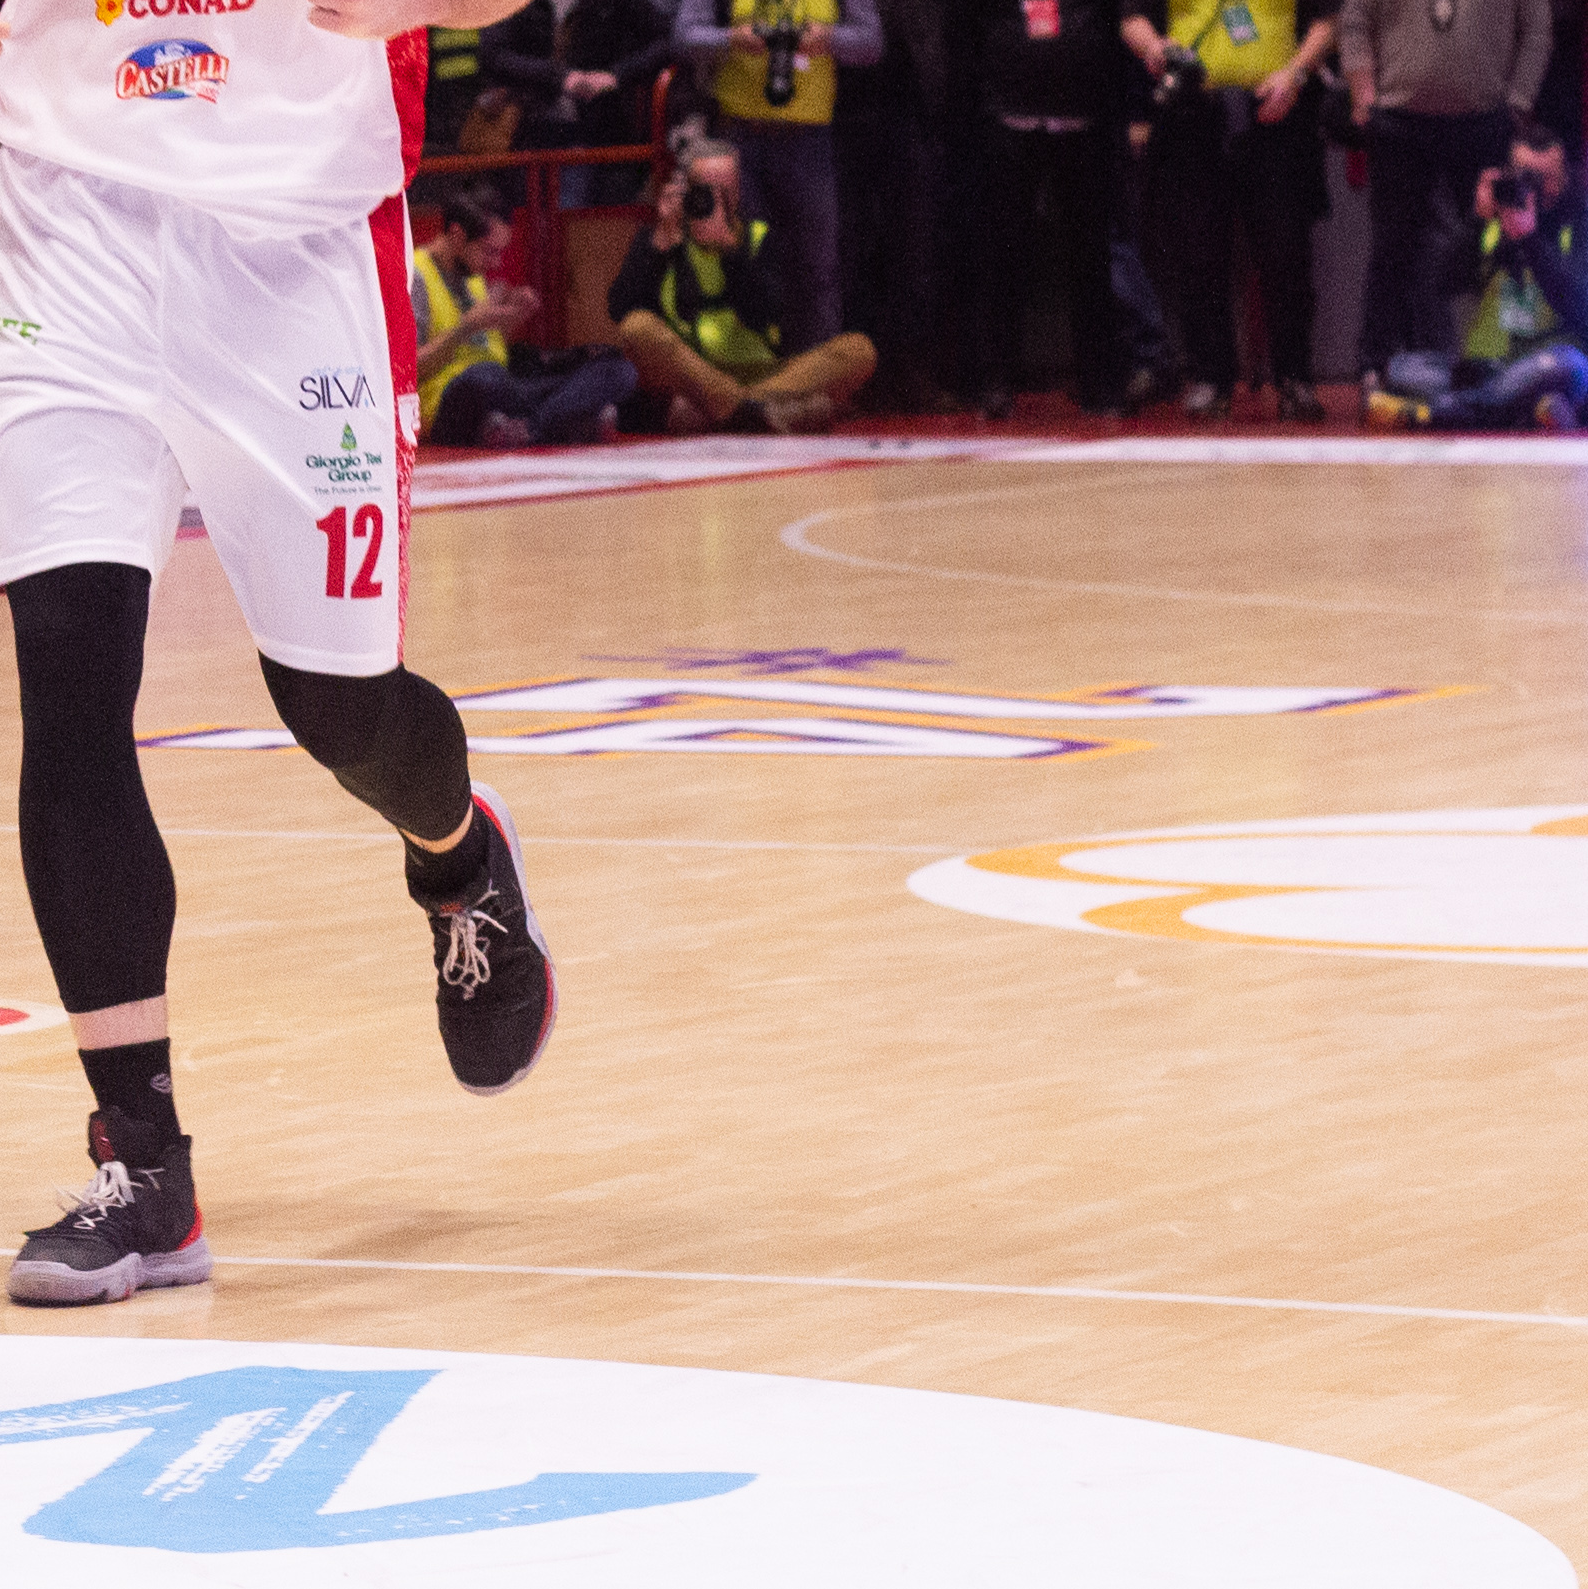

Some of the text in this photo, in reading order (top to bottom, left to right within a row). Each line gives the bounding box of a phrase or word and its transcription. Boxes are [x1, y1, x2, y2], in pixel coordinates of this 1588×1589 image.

[115, 53, 230, 100] CASTELLI
[298, 374, 378, 412] SILVA
[328, 468, 372, 484] Group
[315, 502, 384, 600] 12
